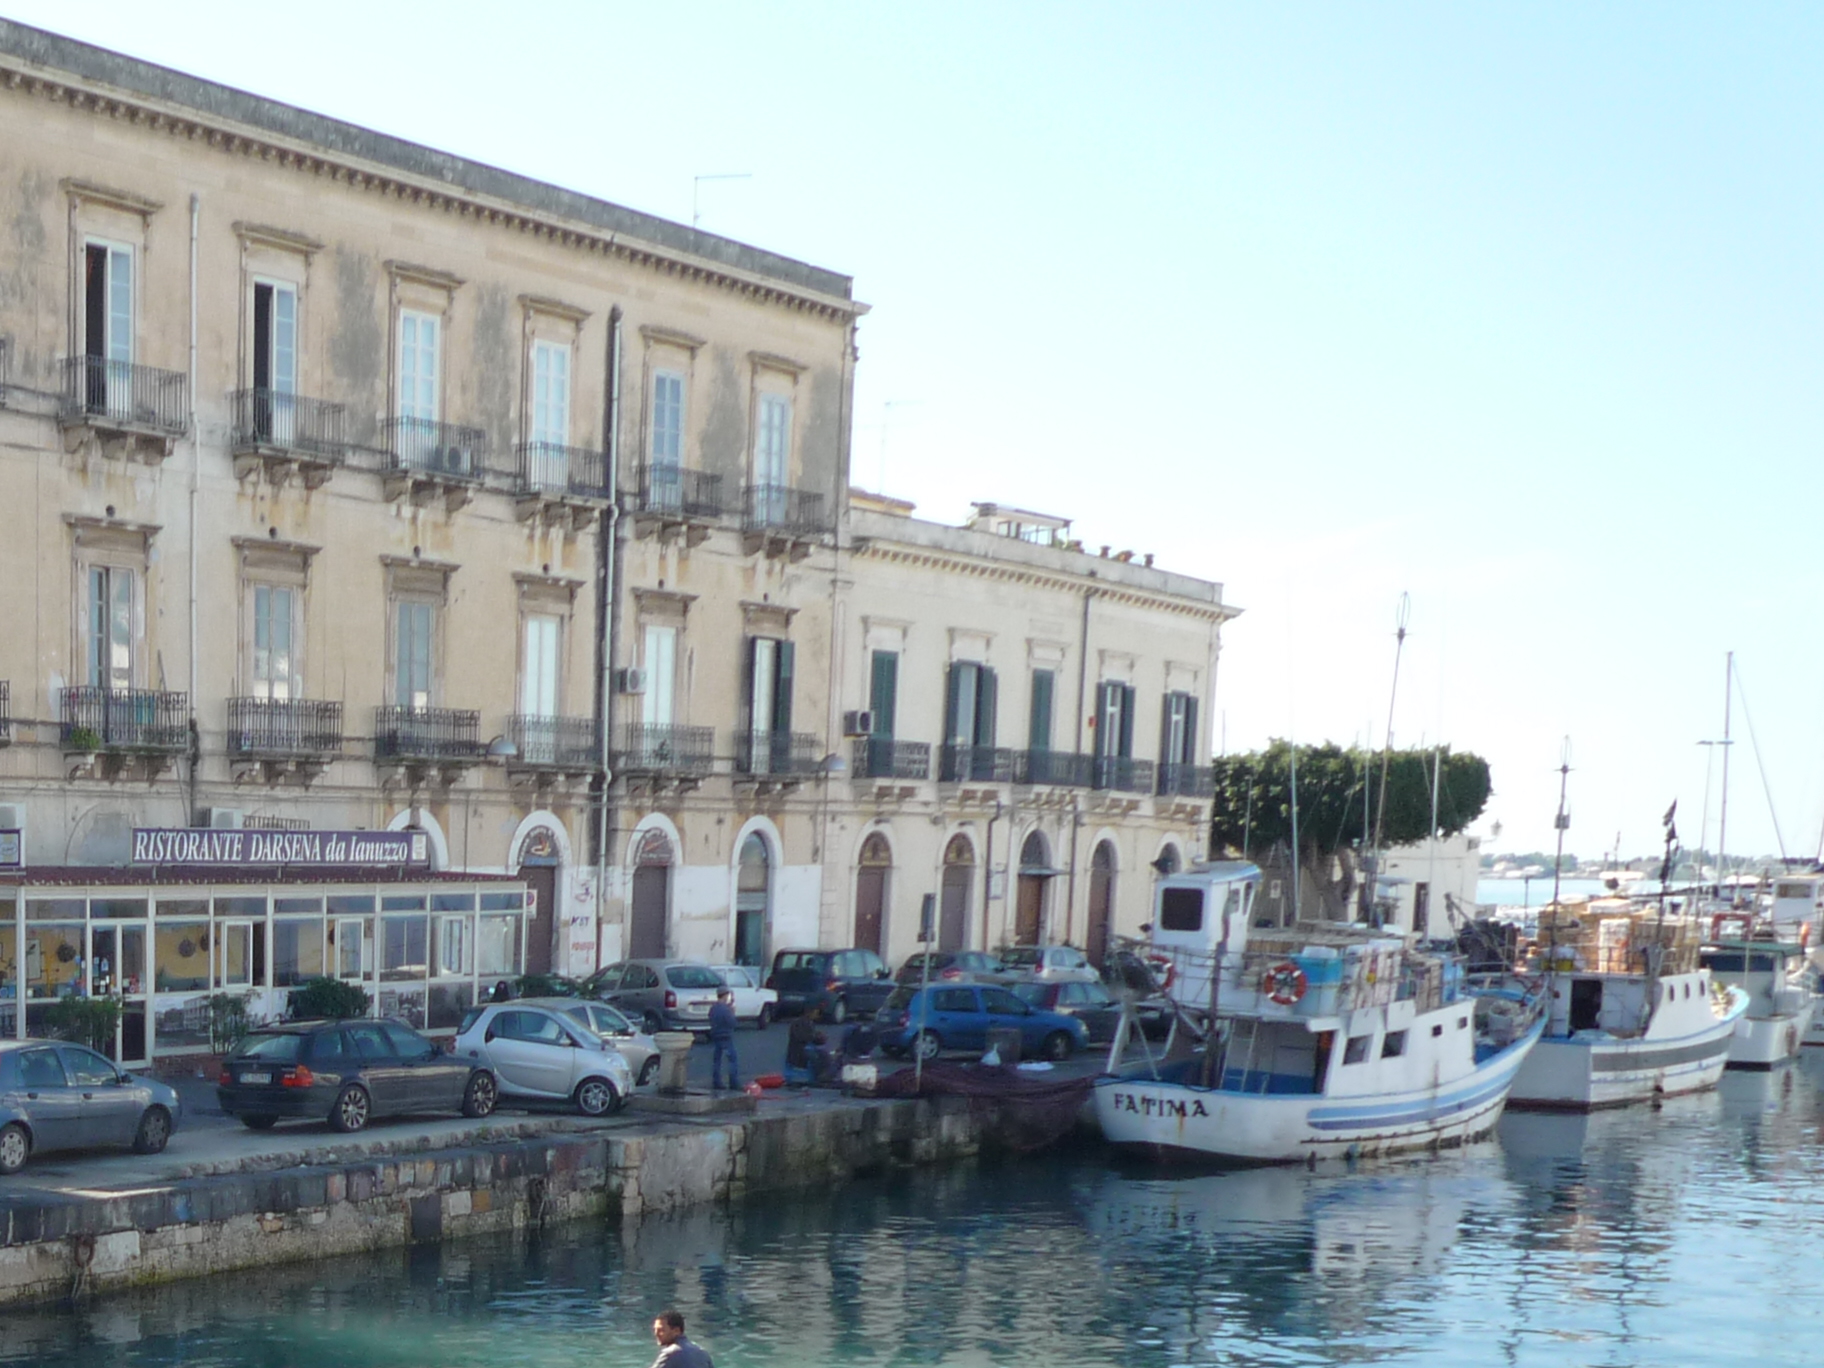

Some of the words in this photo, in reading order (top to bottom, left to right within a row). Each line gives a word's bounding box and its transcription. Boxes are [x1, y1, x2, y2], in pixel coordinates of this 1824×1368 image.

[133, 831, 244, 861] RISTORANTE
[249, 834, 321, 862] DARSENA
[325, 834, 345, 862] da
[1113, 1093, 1209, 1117] FATIMA
